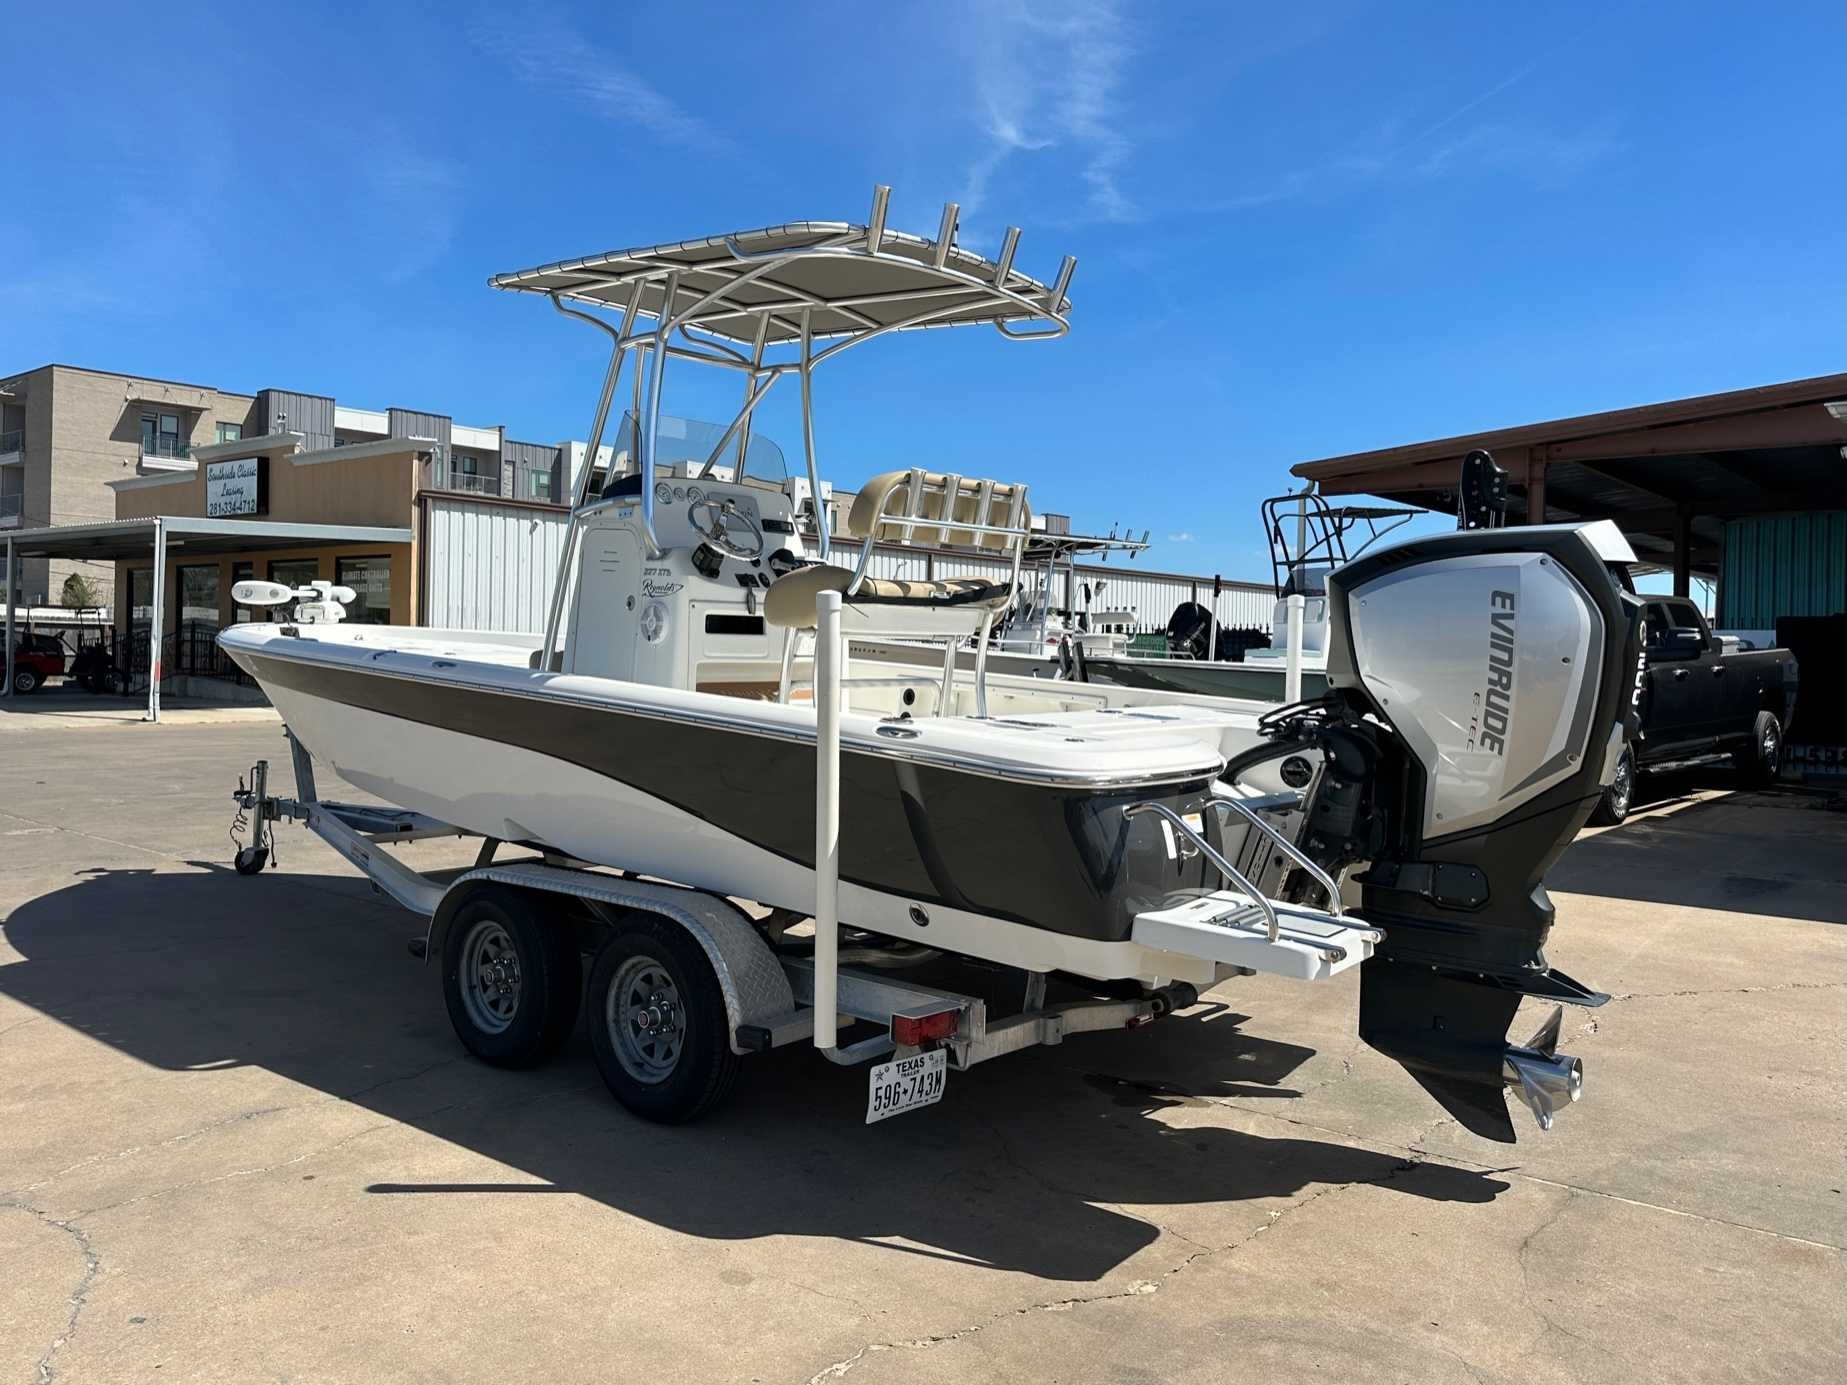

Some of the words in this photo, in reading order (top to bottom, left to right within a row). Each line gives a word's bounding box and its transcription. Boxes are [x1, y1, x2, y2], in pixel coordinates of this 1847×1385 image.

[237, 464, 256, 479] Classic
[221, 482, 244, 498] Leasing
[1479, 590, 1515, 756] EVINRUDE
[896, 1057, 925, 1074] TEXAS
